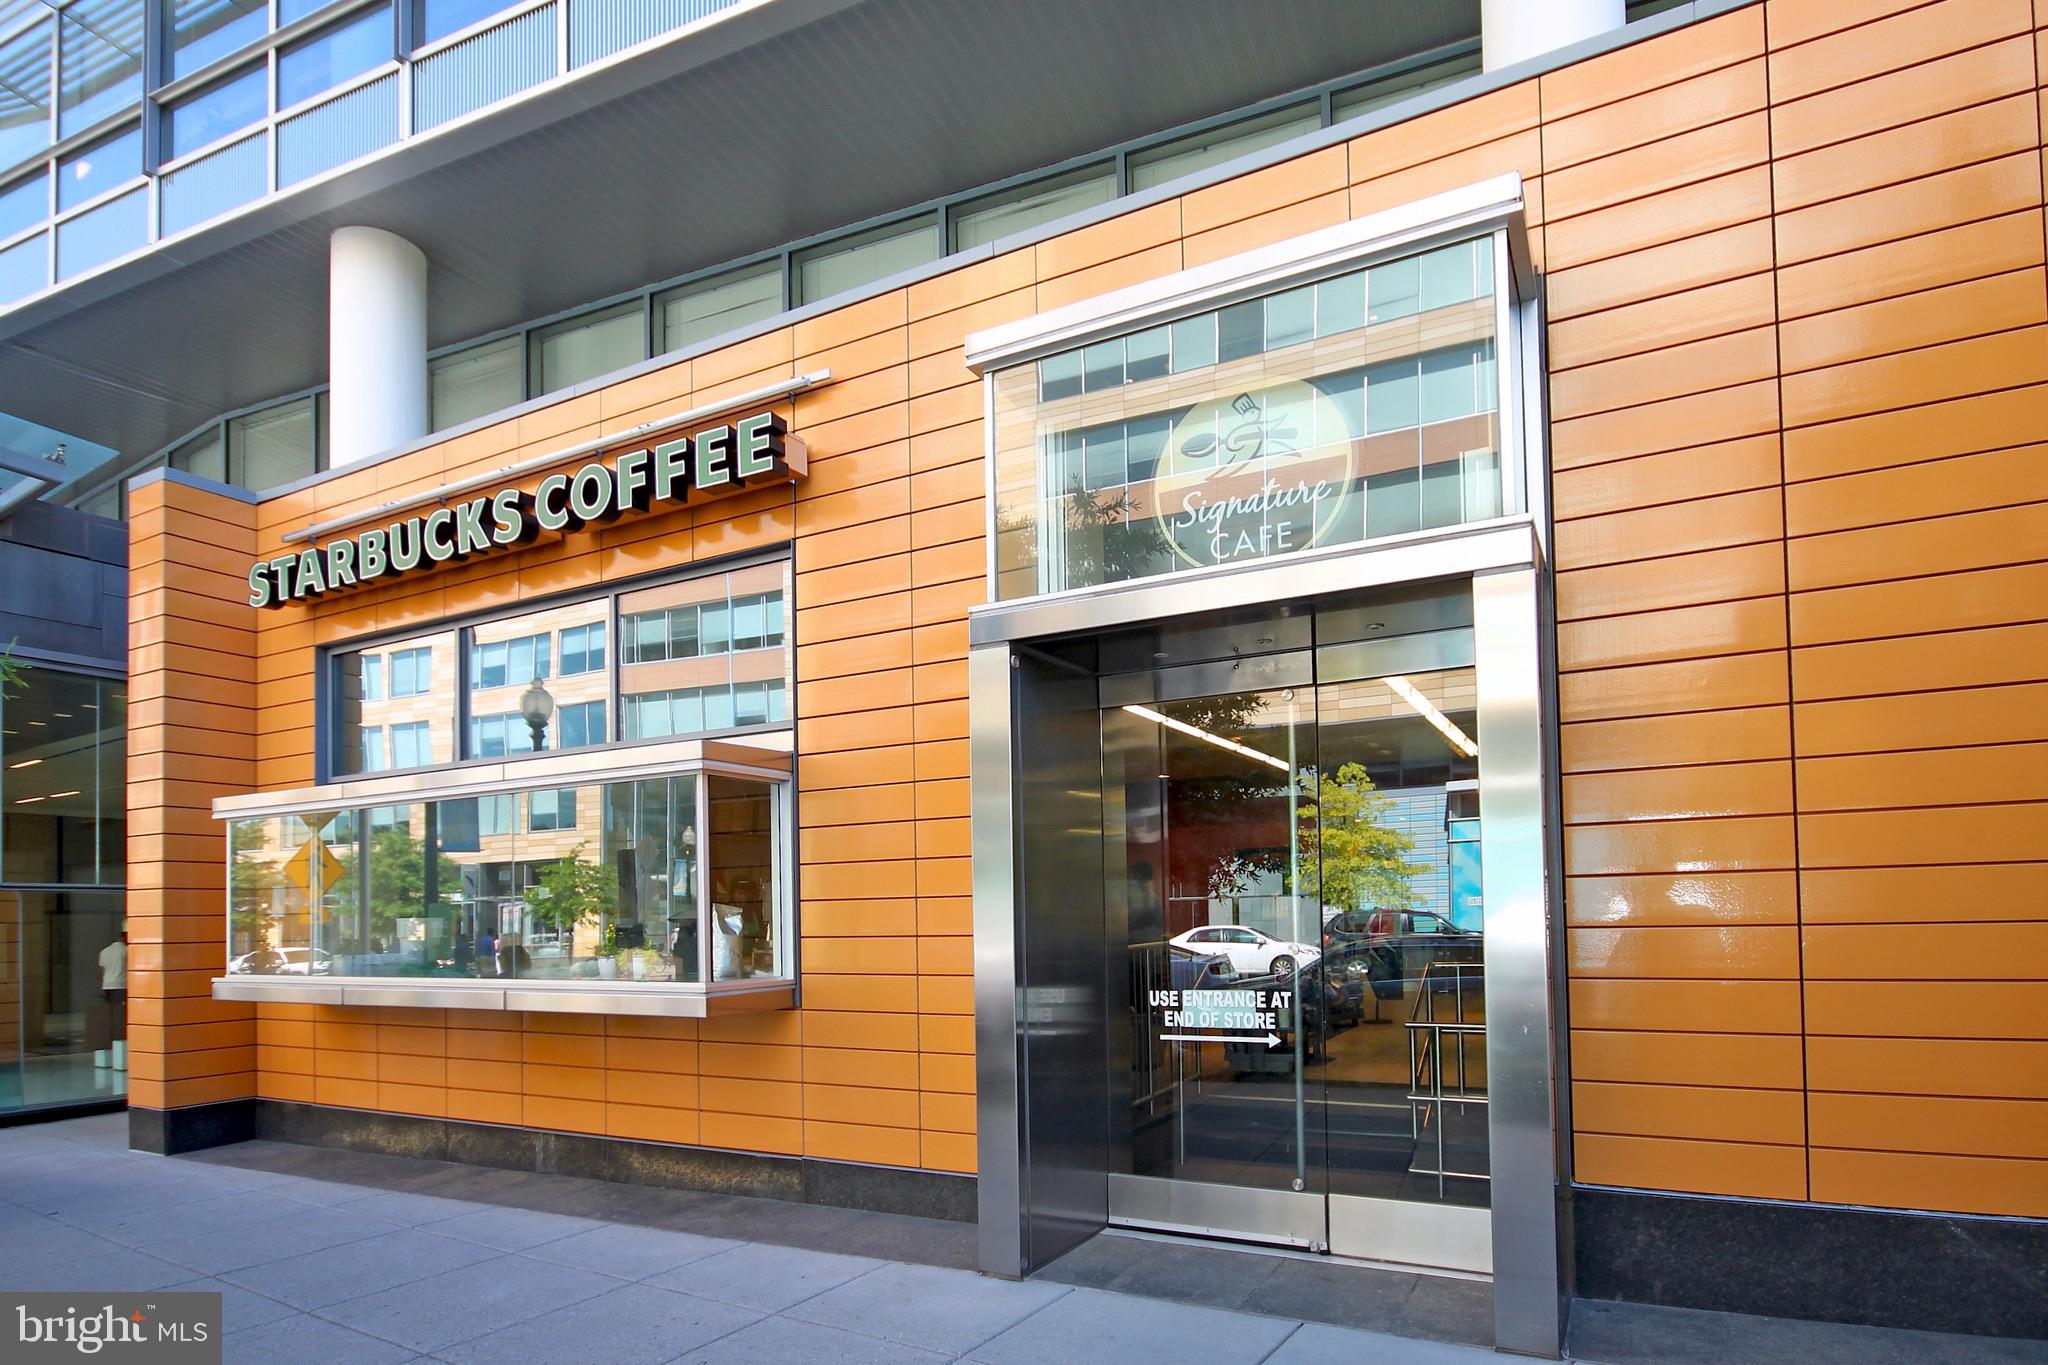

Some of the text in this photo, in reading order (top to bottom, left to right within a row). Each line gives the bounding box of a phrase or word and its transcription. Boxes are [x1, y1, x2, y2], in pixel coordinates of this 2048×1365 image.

[248, 411, 775, 608] STARBUCKS COFFEE
[1176, 478, 1332, 534] Signature
[1210, 521, 1293, 559] CAFE
[1149, 990, 1292, 1009] USE ENTRANCE AT
[1164, 1010, 1276, 1030] END OF STORE
